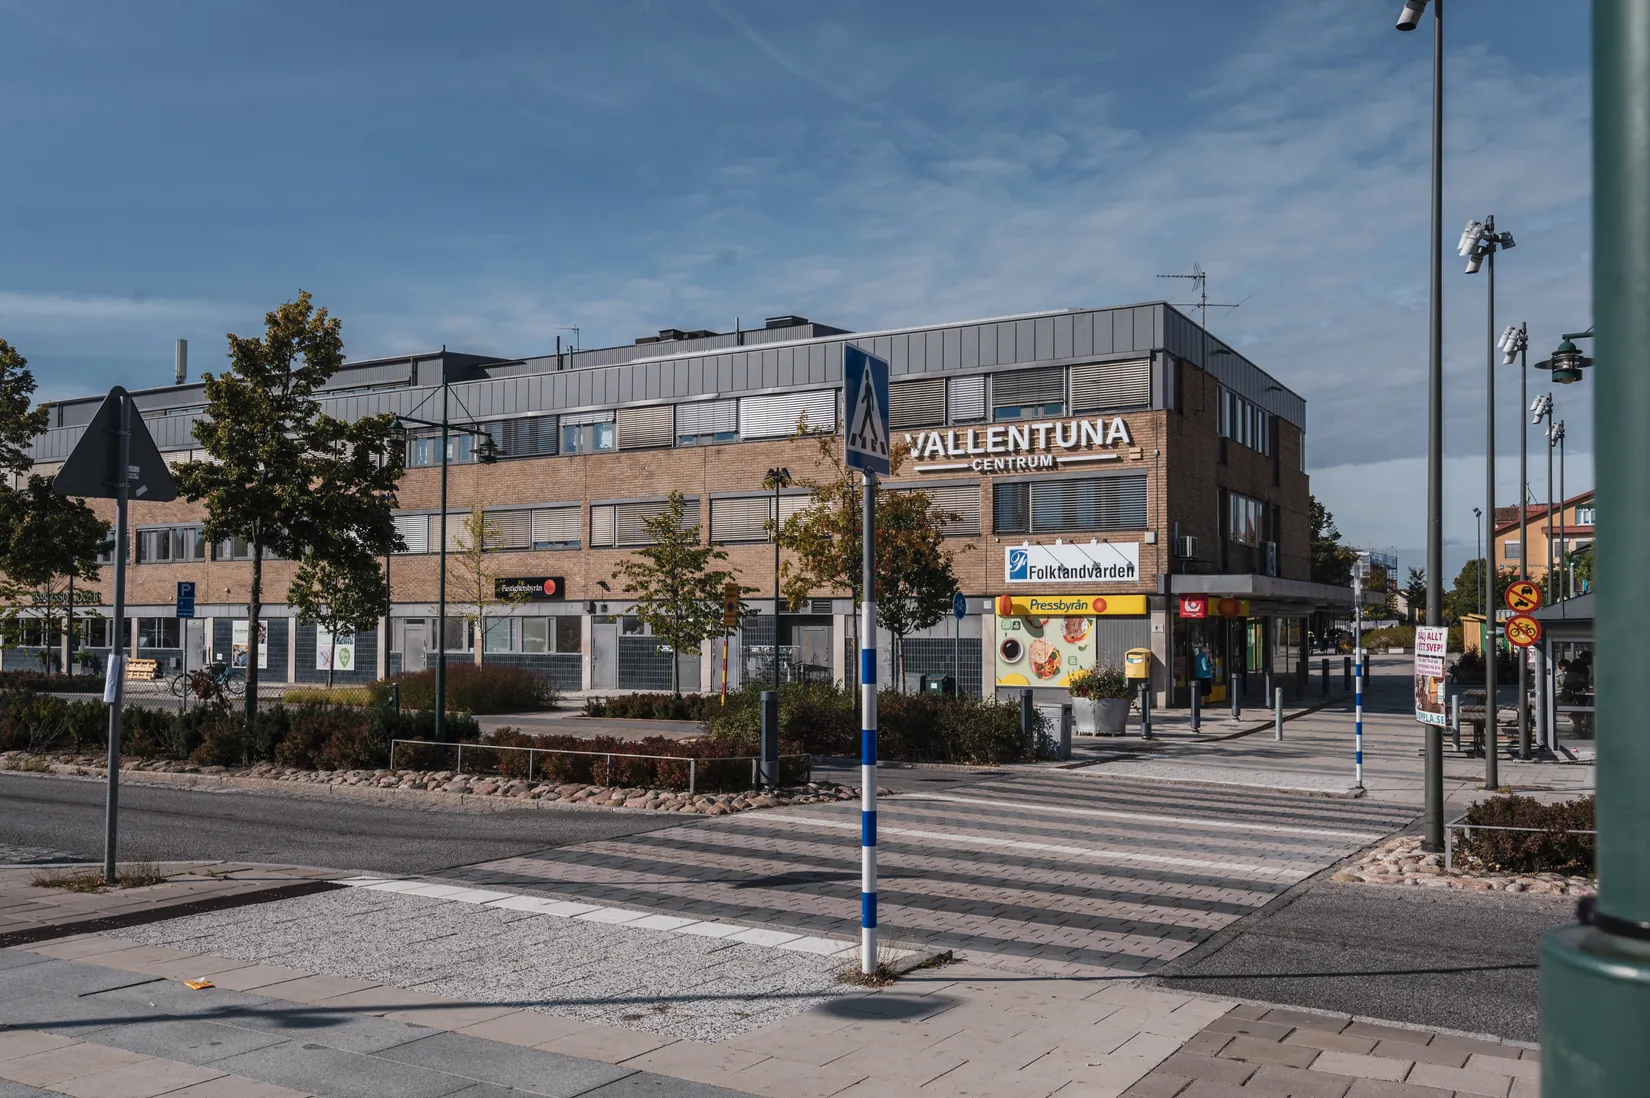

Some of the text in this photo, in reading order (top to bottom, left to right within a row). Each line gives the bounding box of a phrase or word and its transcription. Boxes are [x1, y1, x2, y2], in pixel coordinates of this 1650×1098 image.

[905, 417, 1130, 458] VALLENTUNA
[972, 455, 1053, 471] CENTRUM
[1029, 562, 1135, 580] Folktandvården
[181, 583, 191, 596] P
[1030, 599, 1089, 613] Pressbyrån
[1427, 632, 1443, 641] ALLT
[1426, 643, 1443, 652] SVEP!
